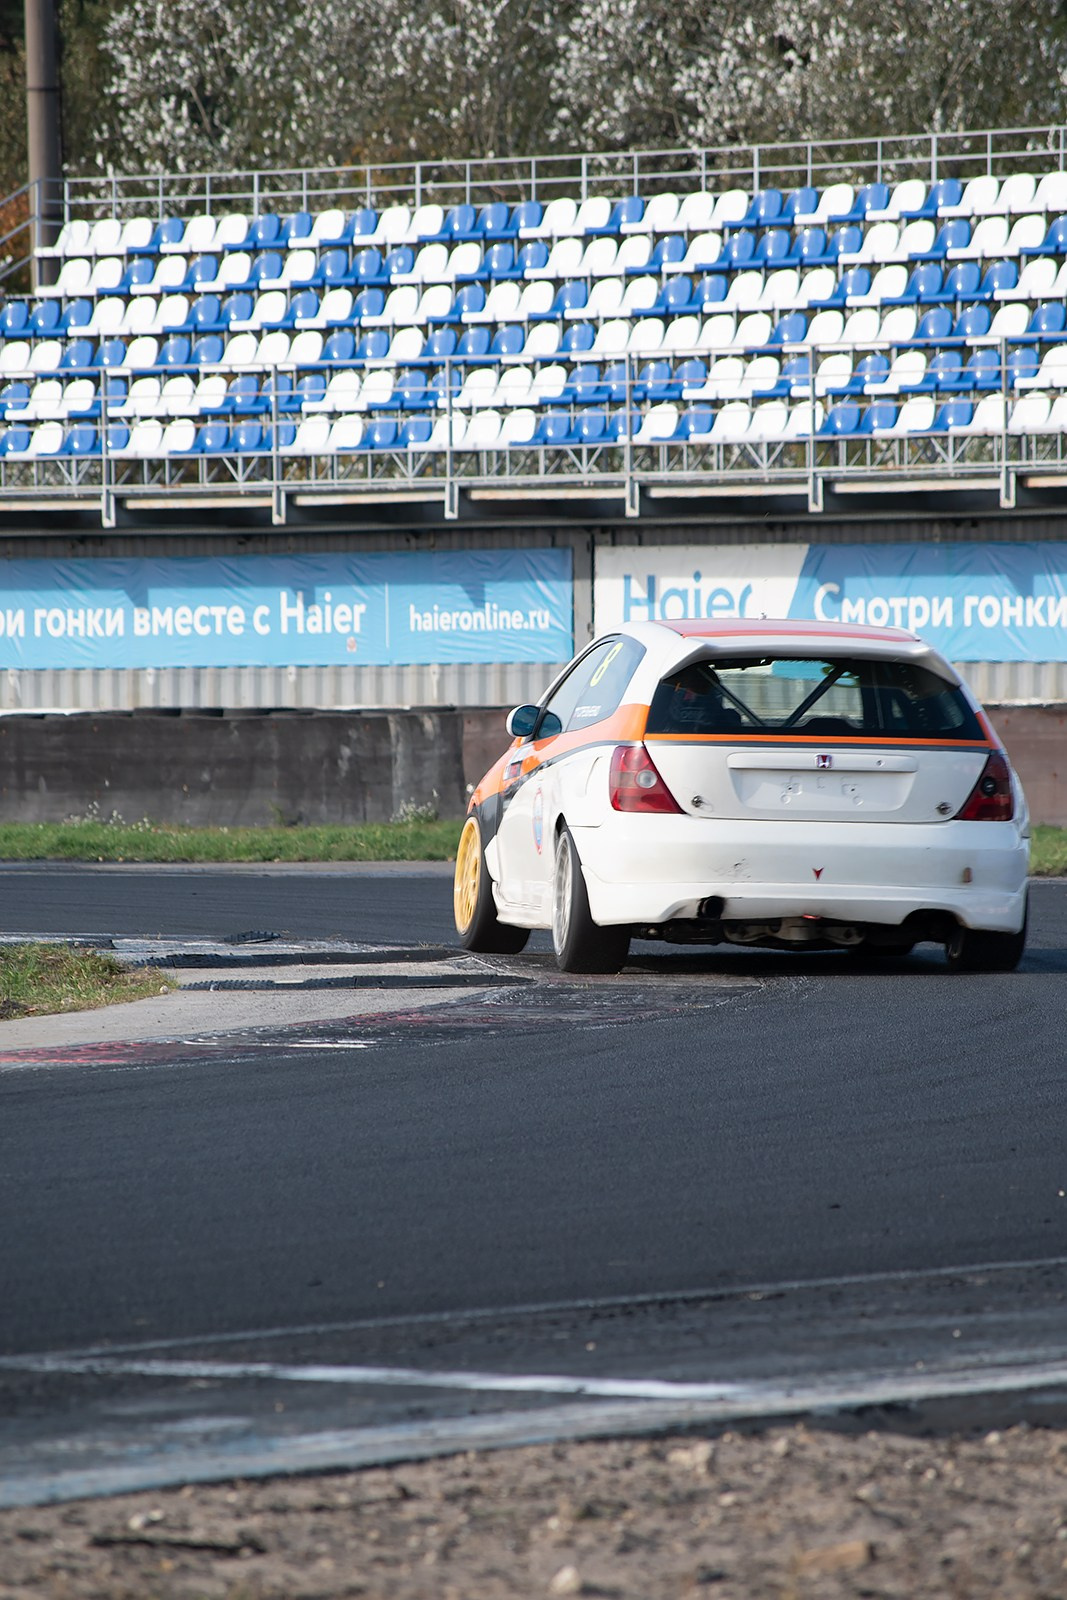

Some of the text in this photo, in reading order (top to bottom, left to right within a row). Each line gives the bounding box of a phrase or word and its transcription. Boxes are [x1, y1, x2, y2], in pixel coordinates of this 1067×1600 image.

[0, 591, 367, 638] и гонки вместе с Haier
[409, 602, 550, 632] haieronline.ru
[623, 570, 753, 622] Haier
[813, 582, 1067, 632] Смотри гонки
[589, 642, 624, 688] 8
